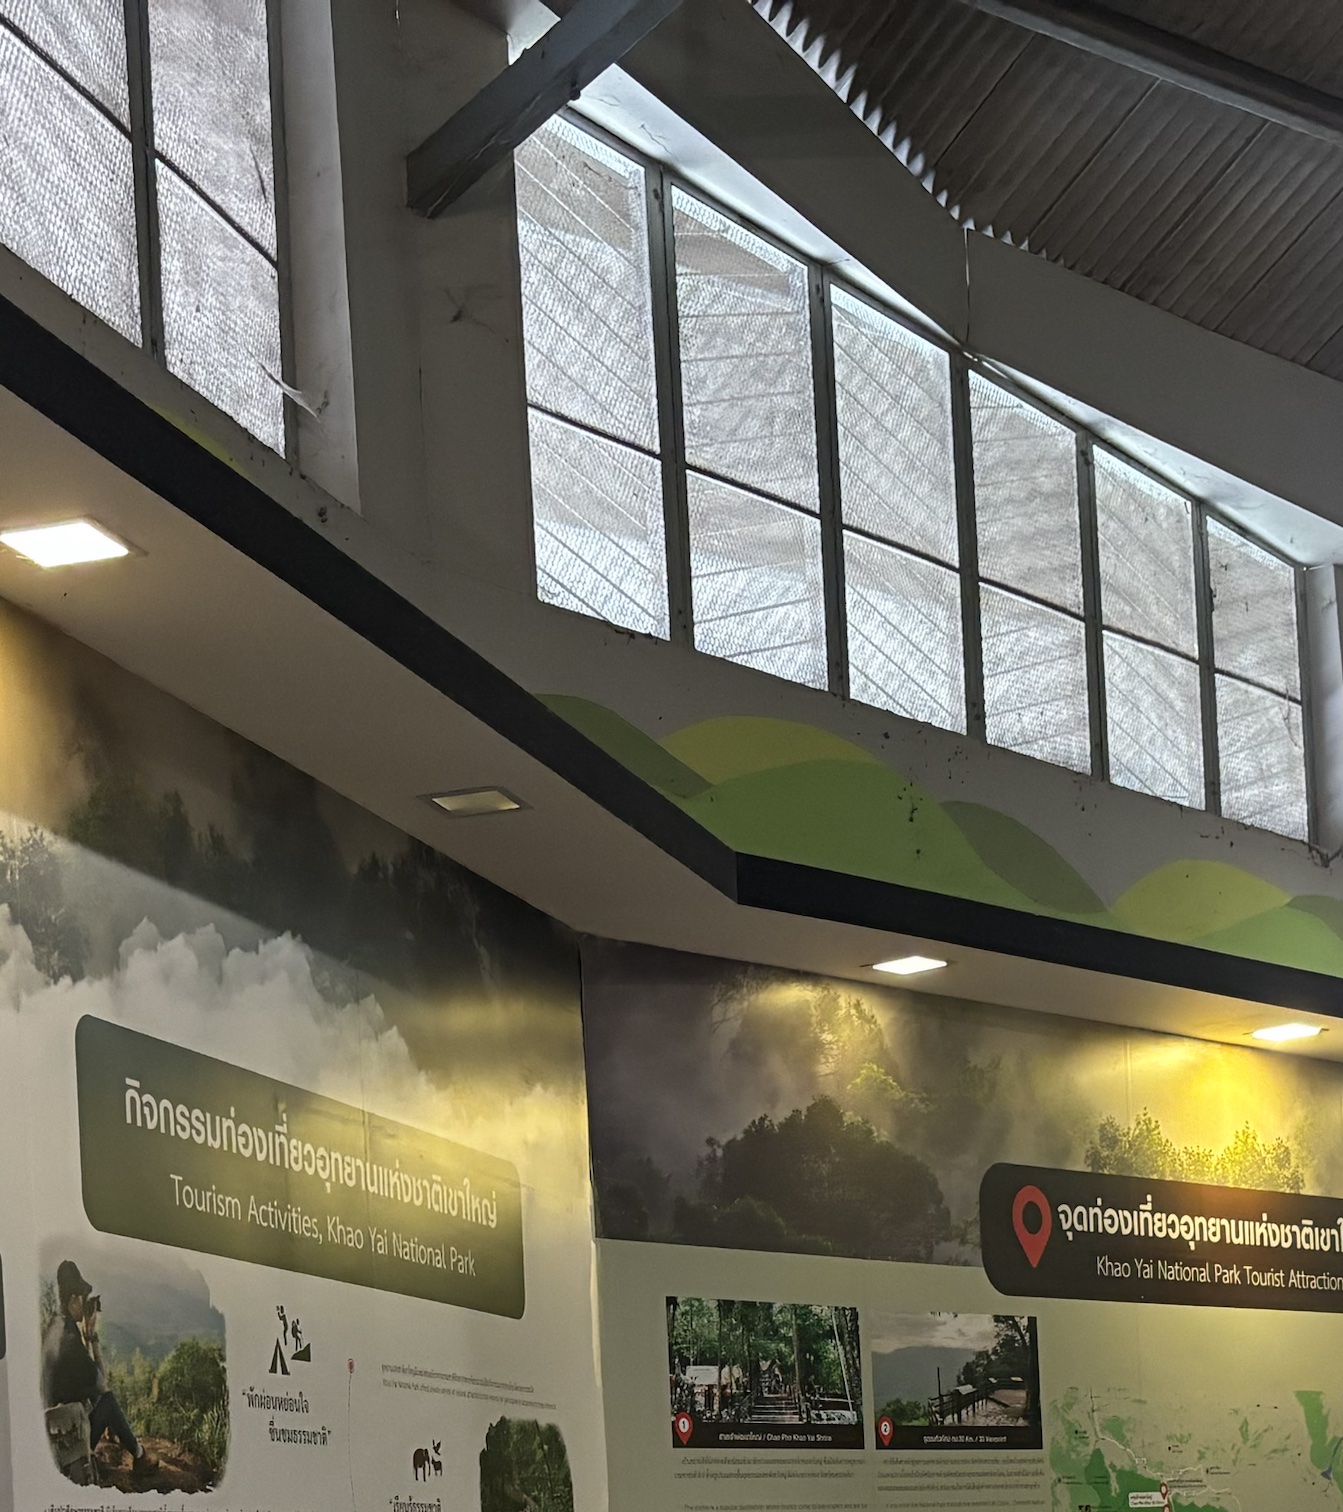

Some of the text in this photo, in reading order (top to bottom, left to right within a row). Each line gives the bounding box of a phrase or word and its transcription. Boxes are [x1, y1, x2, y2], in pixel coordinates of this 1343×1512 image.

[124, 1076, 498, 1230] กิจกรรมท่องเที่ยวอุทยานแห่งชาติเขาใหญ่
[169, 1173, 476, 1278] Tourism Activities, Khao Yai National Park
[1096, 1255, 1131, 1279] Khao
[1134, 1258, 1153, 1280] Yai
[1157, 1259, 1211, 1284] National
[1214, 1264, 1241, 1286] Park
[1243, 1265, 1285, 1288] Tourist
